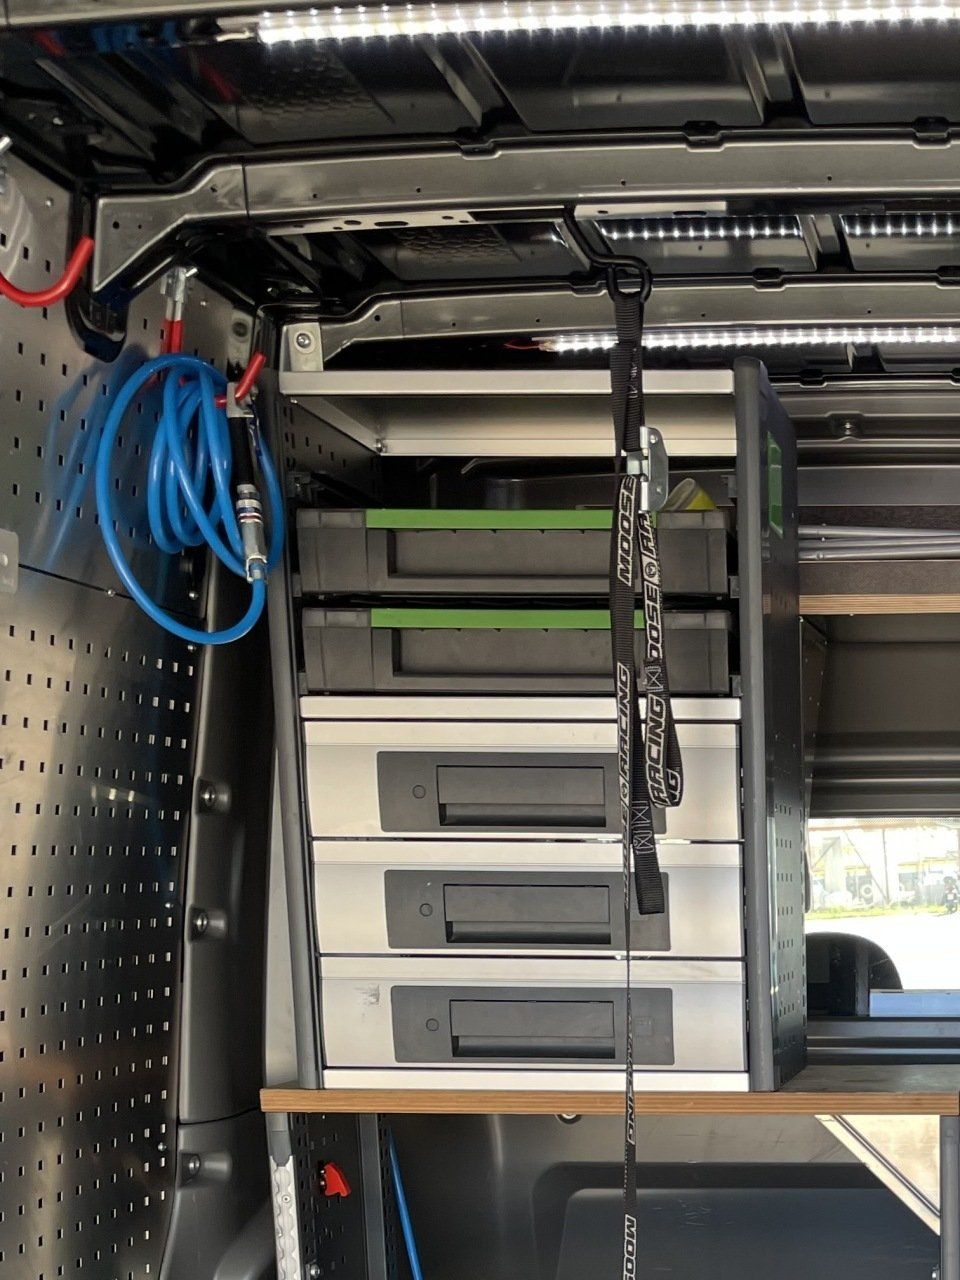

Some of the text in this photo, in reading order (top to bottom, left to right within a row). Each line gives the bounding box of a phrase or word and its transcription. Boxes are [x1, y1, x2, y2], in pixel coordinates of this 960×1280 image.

[617, 475, 637, 587] MOOSE
[617, 662, 630, 781] RACING
[646, 693, 668, 806] RACING
